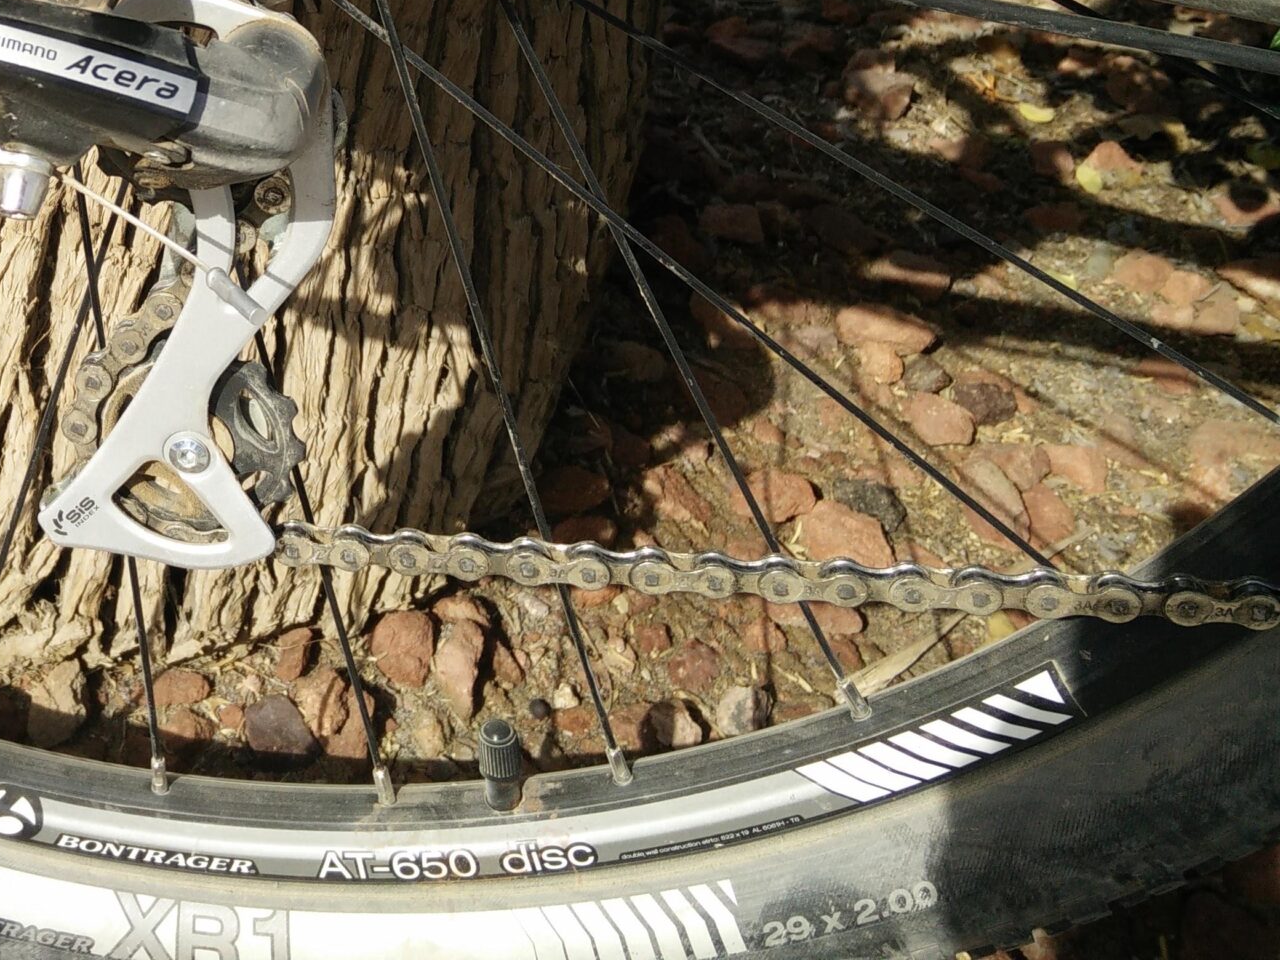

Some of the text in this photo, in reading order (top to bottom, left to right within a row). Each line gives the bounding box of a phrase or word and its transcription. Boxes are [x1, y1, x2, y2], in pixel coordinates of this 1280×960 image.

[66, 54, 180, 100] Acera
[320, 841, 599, 882] AT-650 disc
[103, 888, 291, 960] XR1
[763, 880, 938, 947] 29 x 2.00
